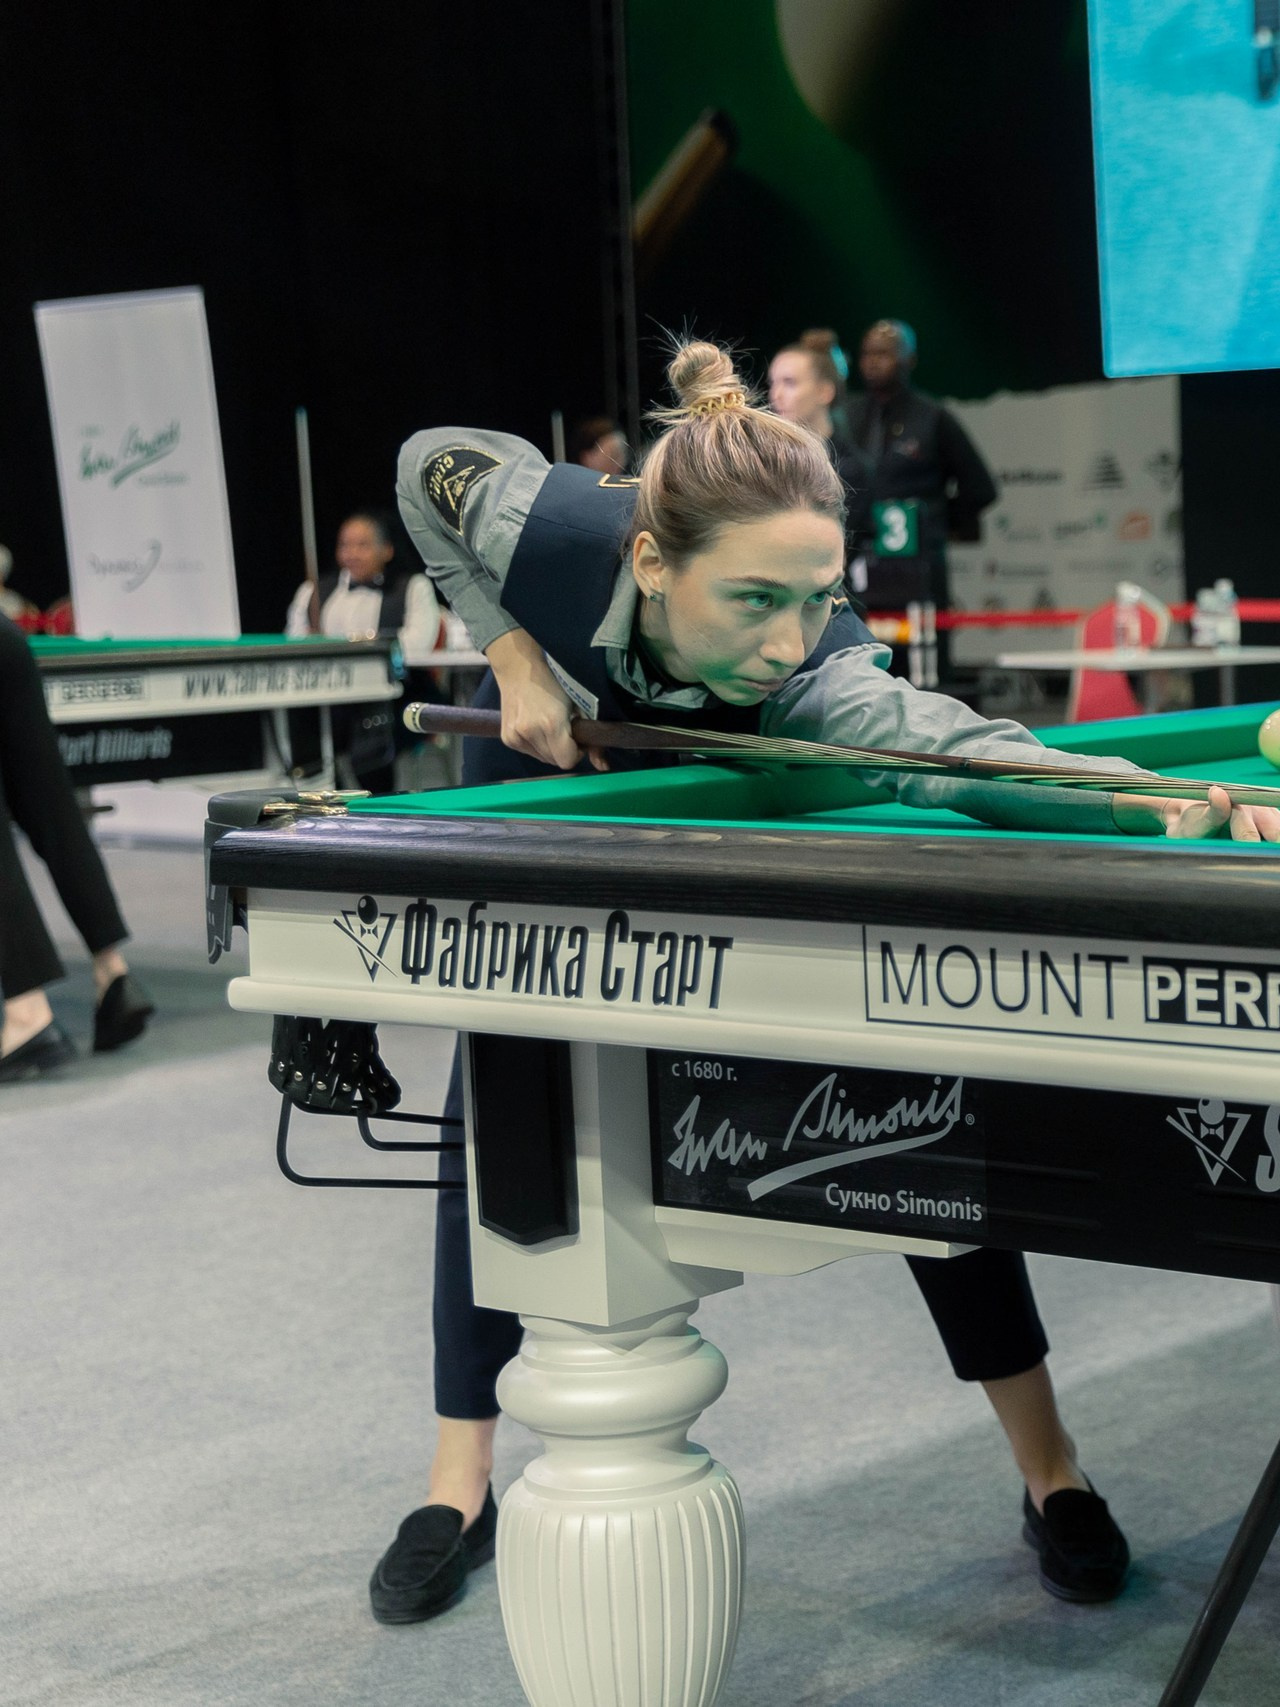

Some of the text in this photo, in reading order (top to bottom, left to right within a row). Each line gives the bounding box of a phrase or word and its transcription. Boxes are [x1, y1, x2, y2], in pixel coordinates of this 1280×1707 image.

[881, 506, 908, 551] 3
[401, 898, 734, 1009] Фабрика Старт
[880, 941, 1129, 1020] MOUNT
[684, 1060, 723, 1081] 1680
[726, 1065, 738, 1082] г.
[825, 1183, 983, 1222] Сукно Simonis
